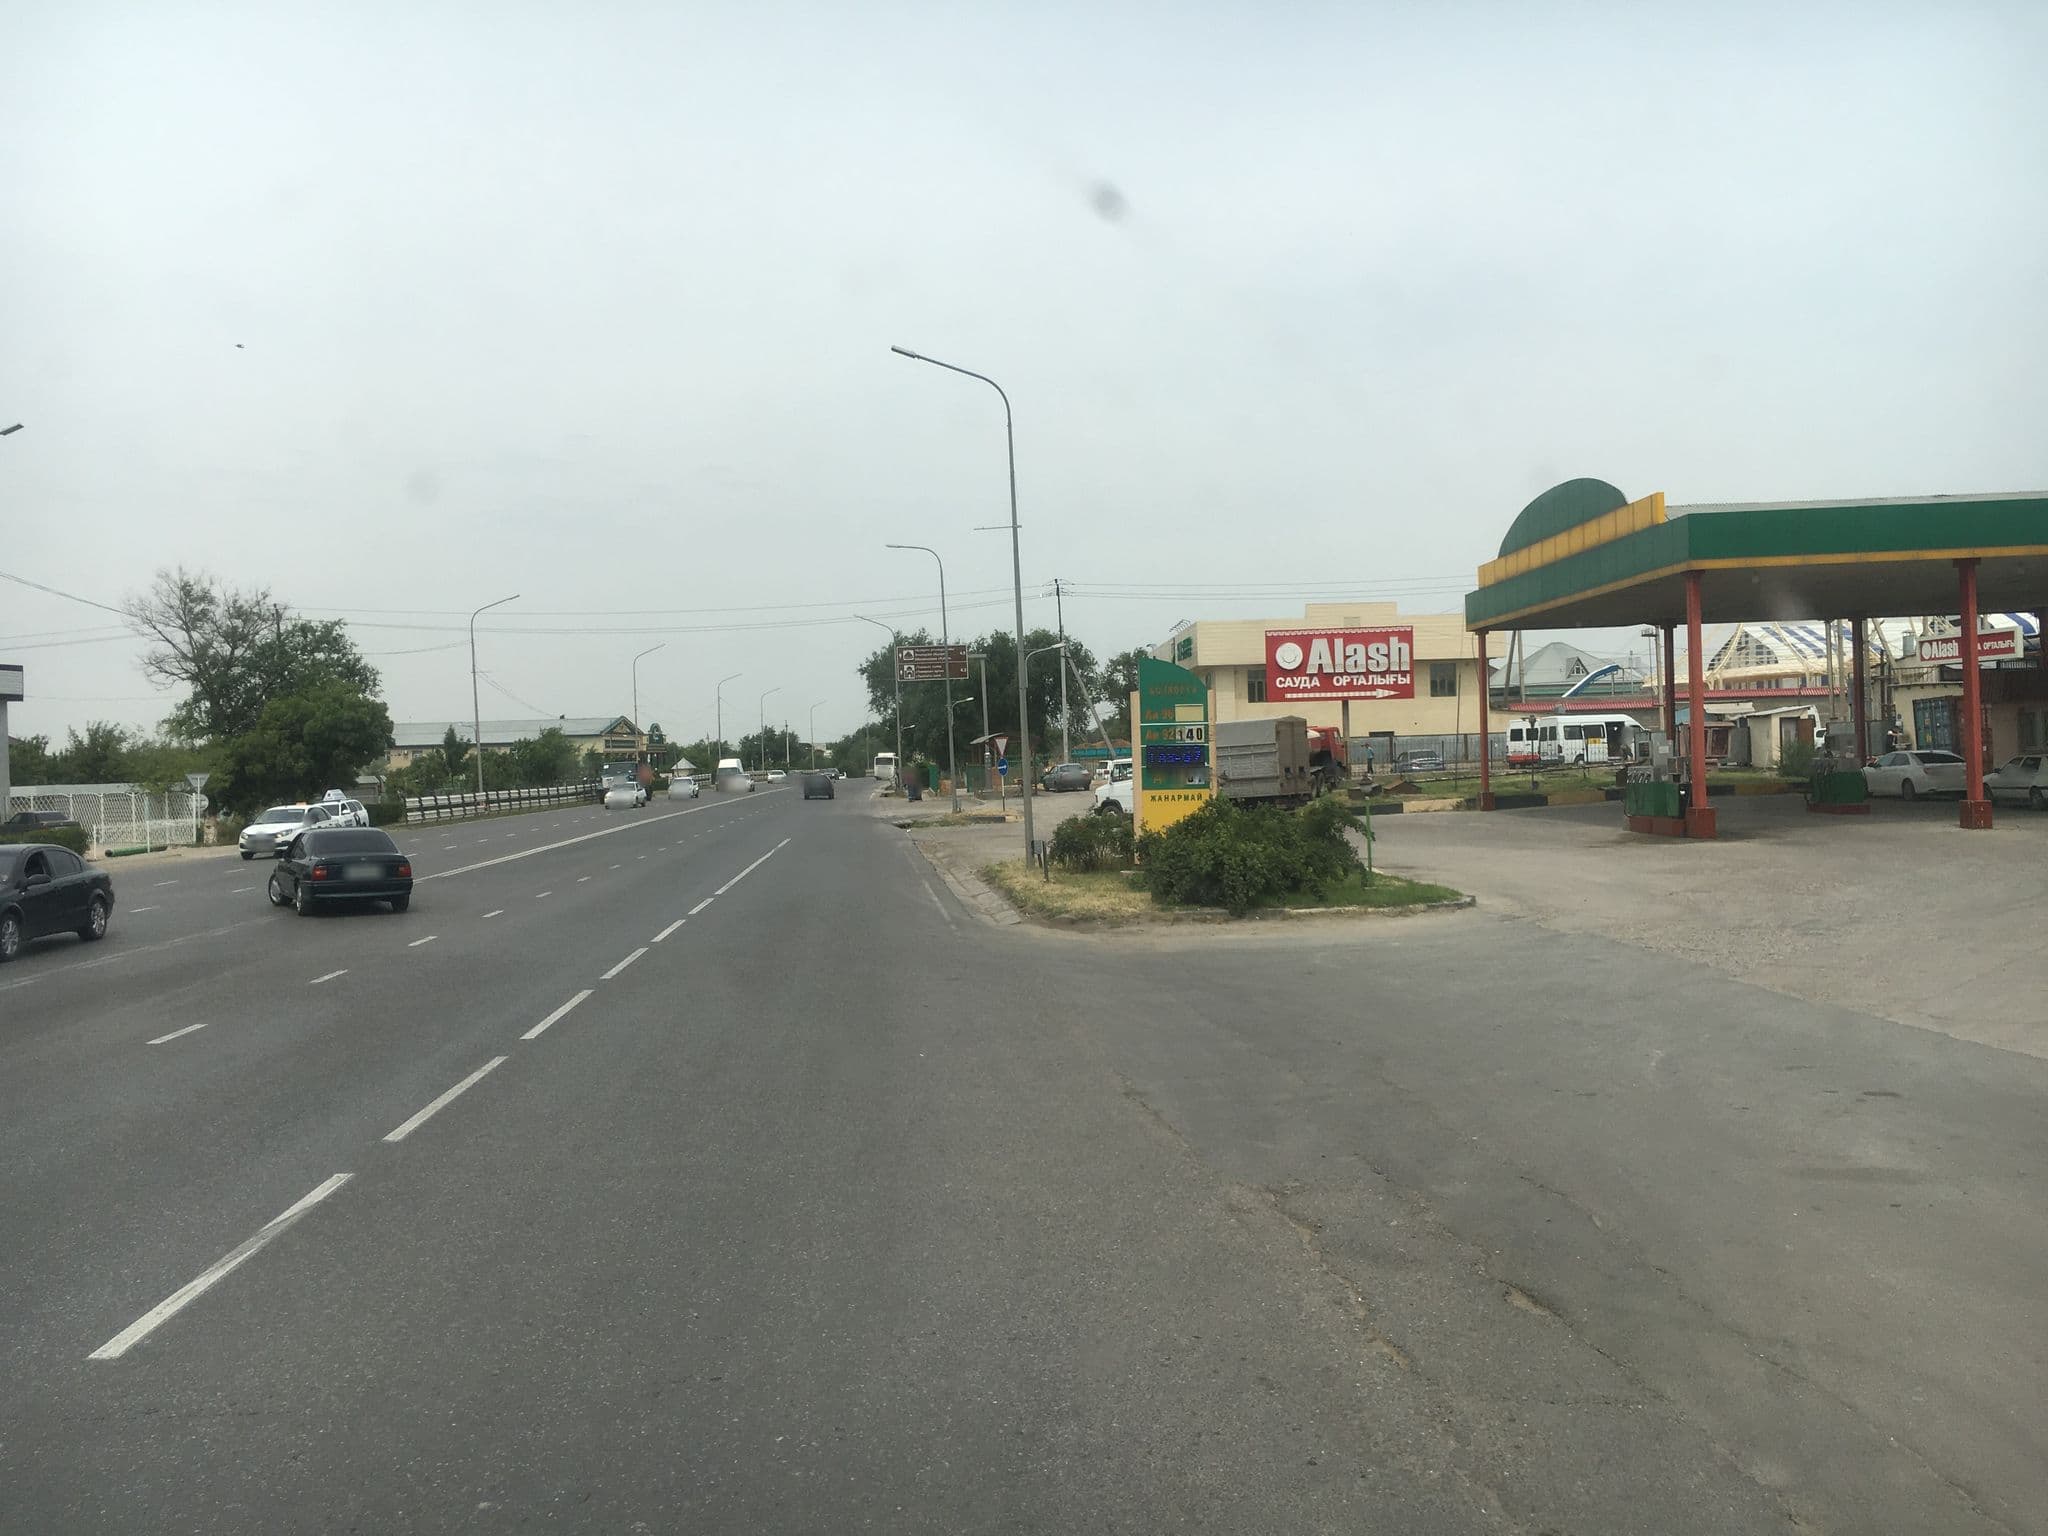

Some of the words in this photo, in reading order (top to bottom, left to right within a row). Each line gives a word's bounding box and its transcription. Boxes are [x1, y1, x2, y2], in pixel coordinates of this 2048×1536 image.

[1306, 636, 1410, 674] Alash
[1931, 640, 1958, 658] Alash
[1276, 676, 1320, 689] САУДА
[1333, 674, 1410, 686] ОРТАЛЫҒЫ
[1150, 793, 1202, 802] ЖАНАРМАЙ
